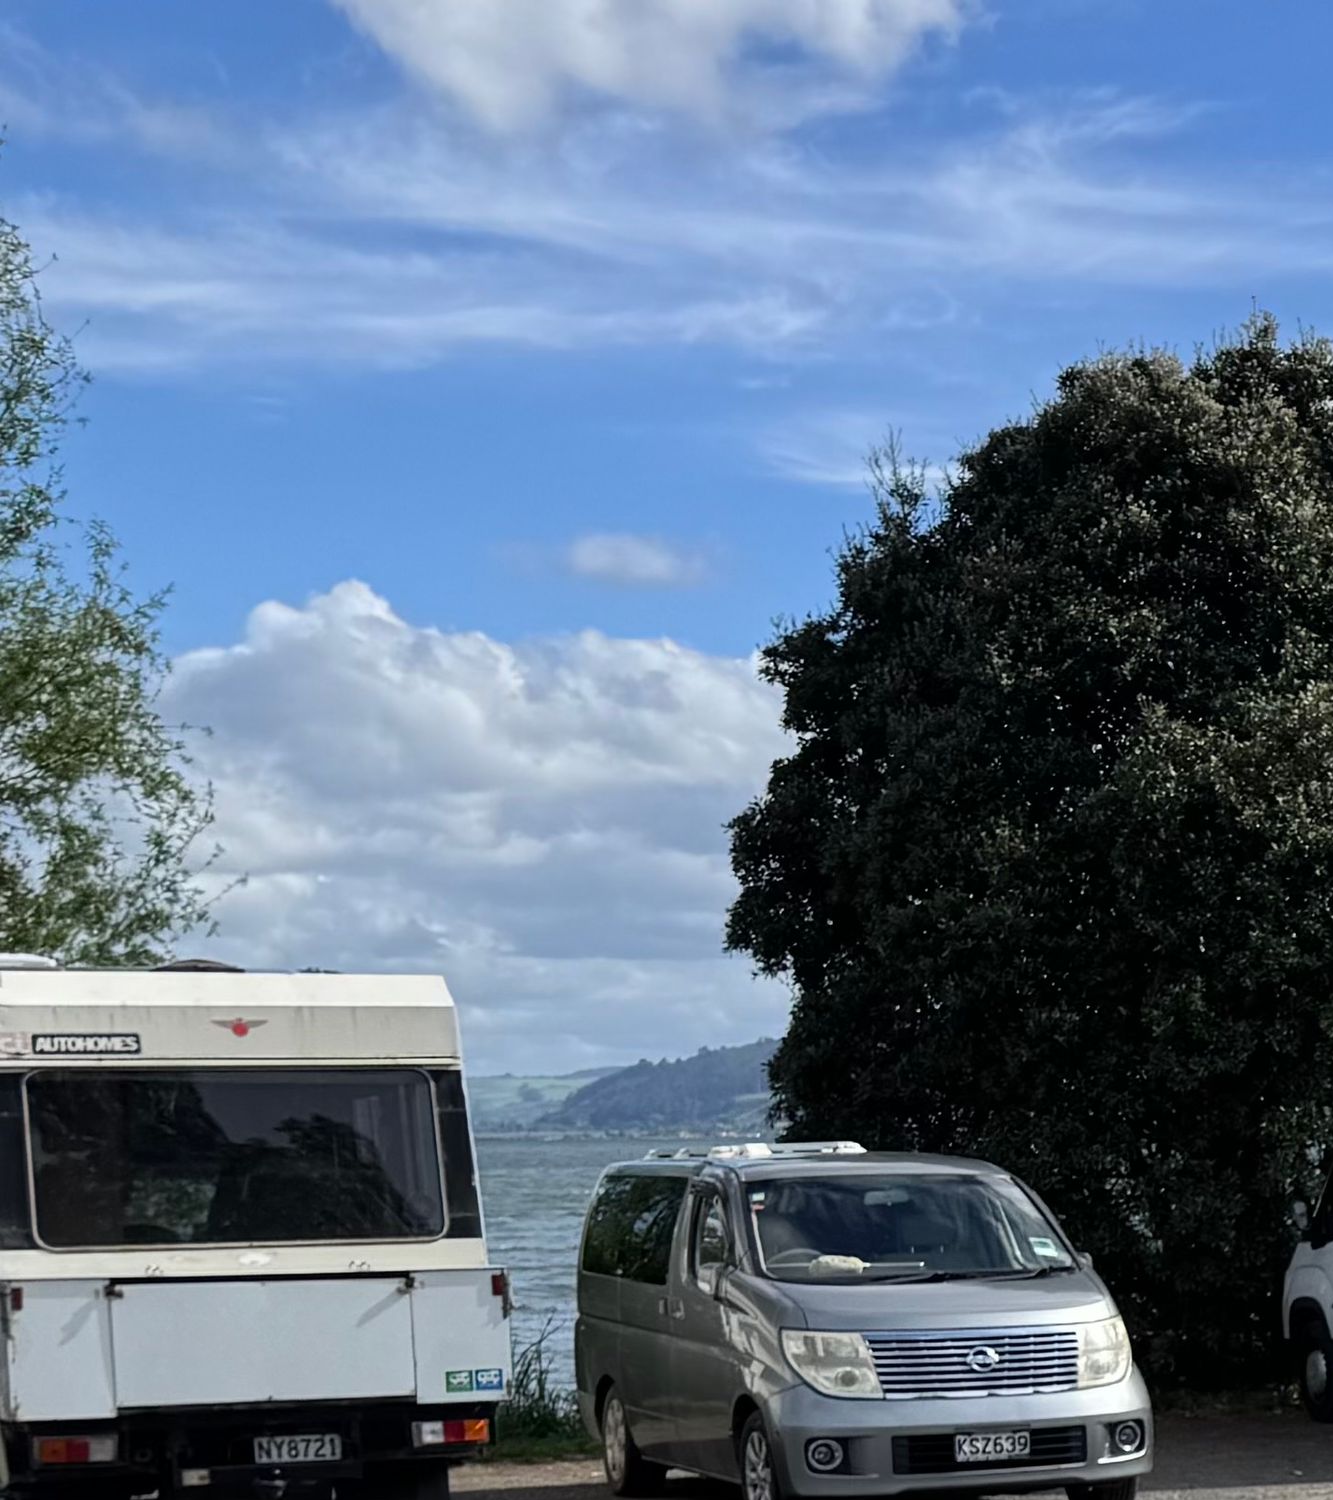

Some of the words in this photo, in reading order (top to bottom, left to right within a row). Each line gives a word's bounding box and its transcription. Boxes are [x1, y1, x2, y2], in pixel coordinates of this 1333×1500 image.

[36, 1036, 138, 1052] AUTOHOMES
[258, 1437, 336, 1459] NY8721
[957, 1435, 1028, 1456] KSZ639
